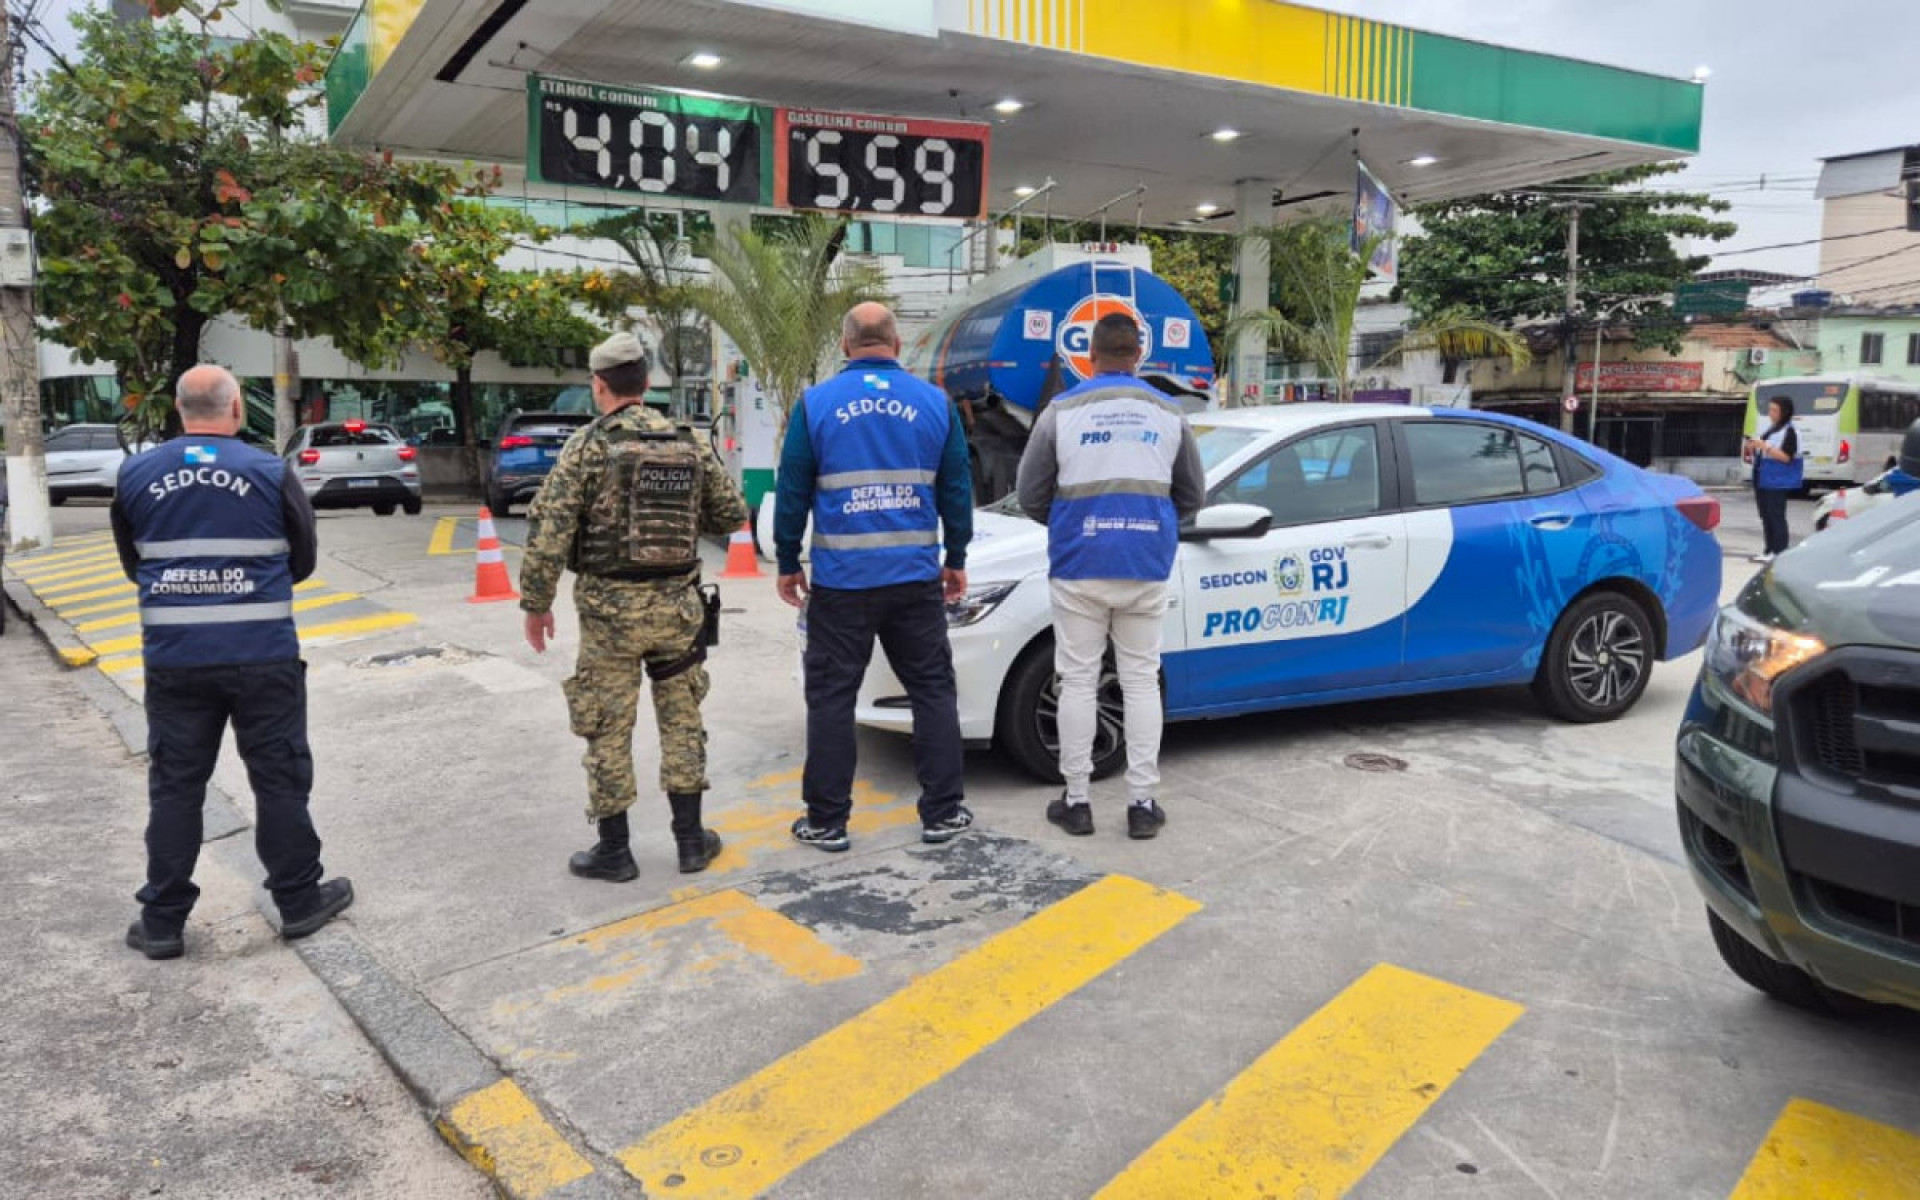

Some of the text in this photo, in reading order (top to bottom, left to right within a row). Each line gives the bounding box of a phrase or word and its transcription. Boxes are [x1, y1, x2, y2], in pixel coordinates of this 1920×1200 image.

[540, 79, 594, 99] ETANOL
[788, 111, 853, 128] GASOLINA
[563, 108, 731, 192] 4,04
[807, 130, 955, 215] 5,59
[836, 397, 918, 424] SEDCON
[1080, 431, 1159, 446] PRORJ
[149, 467, 251, 500] SEDCON
[640, 480, 691, 491] MILITAR
[851, 485, 913, 500] DEFESA DO
[843, 496, 920, 514] CONSUMIDOR
[1310, 547, 1345, 562] GOV
[161, 568, 244, 582] DEFESA DO
[1200, 570, 1268, 589] SEDCON
[1311, 561, 1349, 592] RJ
[151, 581, 254, 595] CONSUMIDOR
[1202, 596, 1350, 637] PROCONRJ
